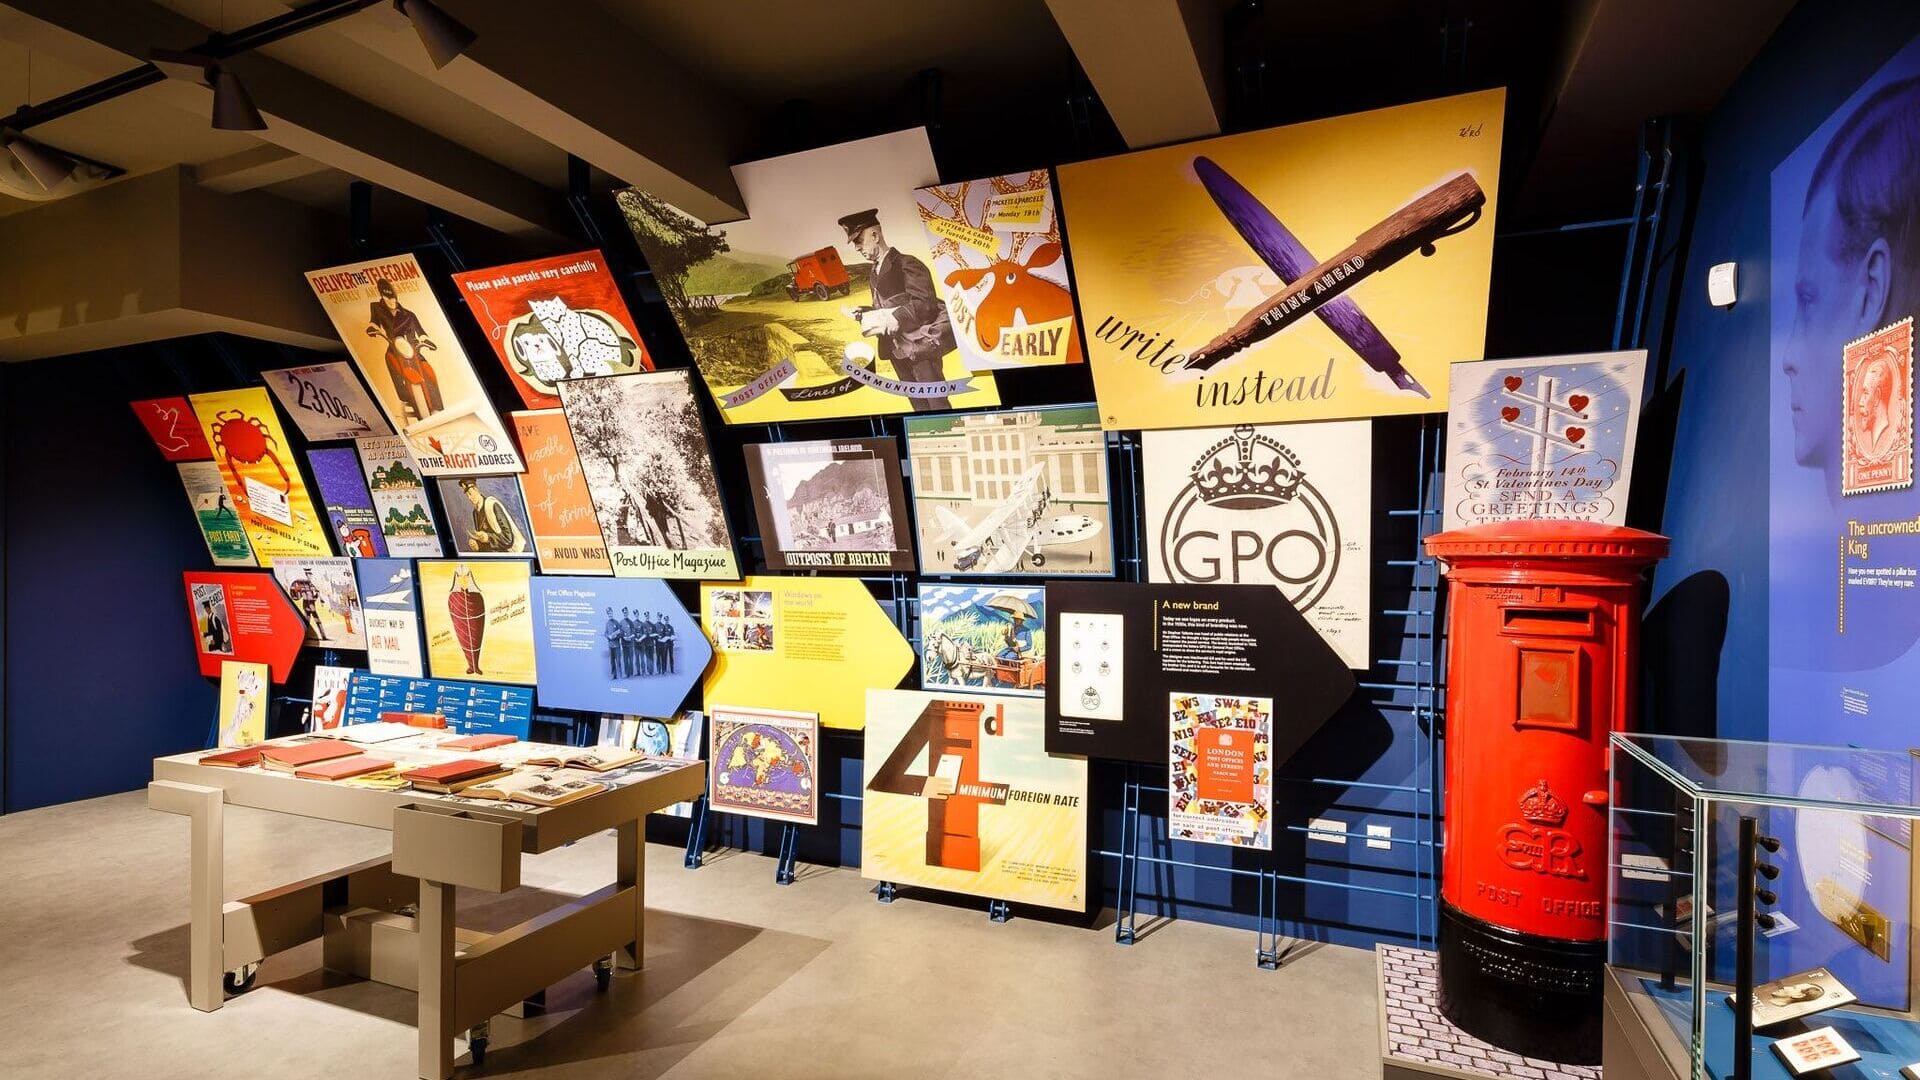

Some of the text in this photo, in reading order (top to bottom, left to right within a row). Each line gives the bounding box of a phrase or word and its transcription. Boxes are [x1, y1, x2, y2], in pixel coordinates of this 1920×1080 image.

[1024, 209, 1040, 217] 19th
[940, 221, 966, 232] LETTERS
[972, 231, 994, 242] CARDS
[945, 228, 971, 243] Tuesday
[972, 237, 991, 249] 20th
[312, 261, 420, 294] DELIVER THE TELEGRAM
[465, 259, 597, 292] Please pack parcels very carefully
[1259, 255, 1365, 327] THINK AHEAD
[952, 293, 975, 336] POST
[1001, 327, 1063, 357] EARLY
[1095, 315, 1186, 375] write
[732, 365, 788, 404] POST OFFICE
[846, 364, 957, 394] COMMUNICATION
[1196, 357, 1336, 408] instead
[791, 380, 852, 399] Lines of
[418, 453, 515, 469] TO THE RIGHT ADDRESS
[1496, 466, 1586, 479] February 14th
[1495, 479, 1569, 489] Valentines
[1573, 477, 1603, 488] Day
[1500, 490, 1577, 501] SEND A
[1472, 501, 1600, 515] GREETINGS
[1848, 515, 1920, 536] The uncrowned
[208, 530, 241, 542] POST EARLY
[554, 548, 578, 559] AVOID
[1173, 529, 1326, 584] GPO
[1848, 539, 1868, 559] King
[613, 551, 727, 573] Post Office Magazine
[786, 552, 892, 567] OUTPOSTS OF BRITAIN
[1875, 568, 1892, 576] spotted
[1907, 568, 1917, 576] box
[1893, 579, 1903, 588] very
[193, 585, 206, 600] POST
[209, 590, 223, 606] EARLY
[1162, 600, 1170, 609] A
[1193, 601, 1219, 610] brand
[371, 635, 400, 651] AIR MAIL
[1181, 697, 1240, 709] W5 SW4
[1173, 710, 1188, 721] E2
[1235, 718, 1256, 729] E10
[1172, 727, 1195, 741] N19
[1172, 745, 1197, 763] SE17
[1207, 748, 1244, 757] LONDON
[1221, 757, 1243, 765] OFFICES
[959, 784, 1079, 808] MINIMUM FOREIGN RATE
[1477, 881, 1600, 918] POST OFFICE
